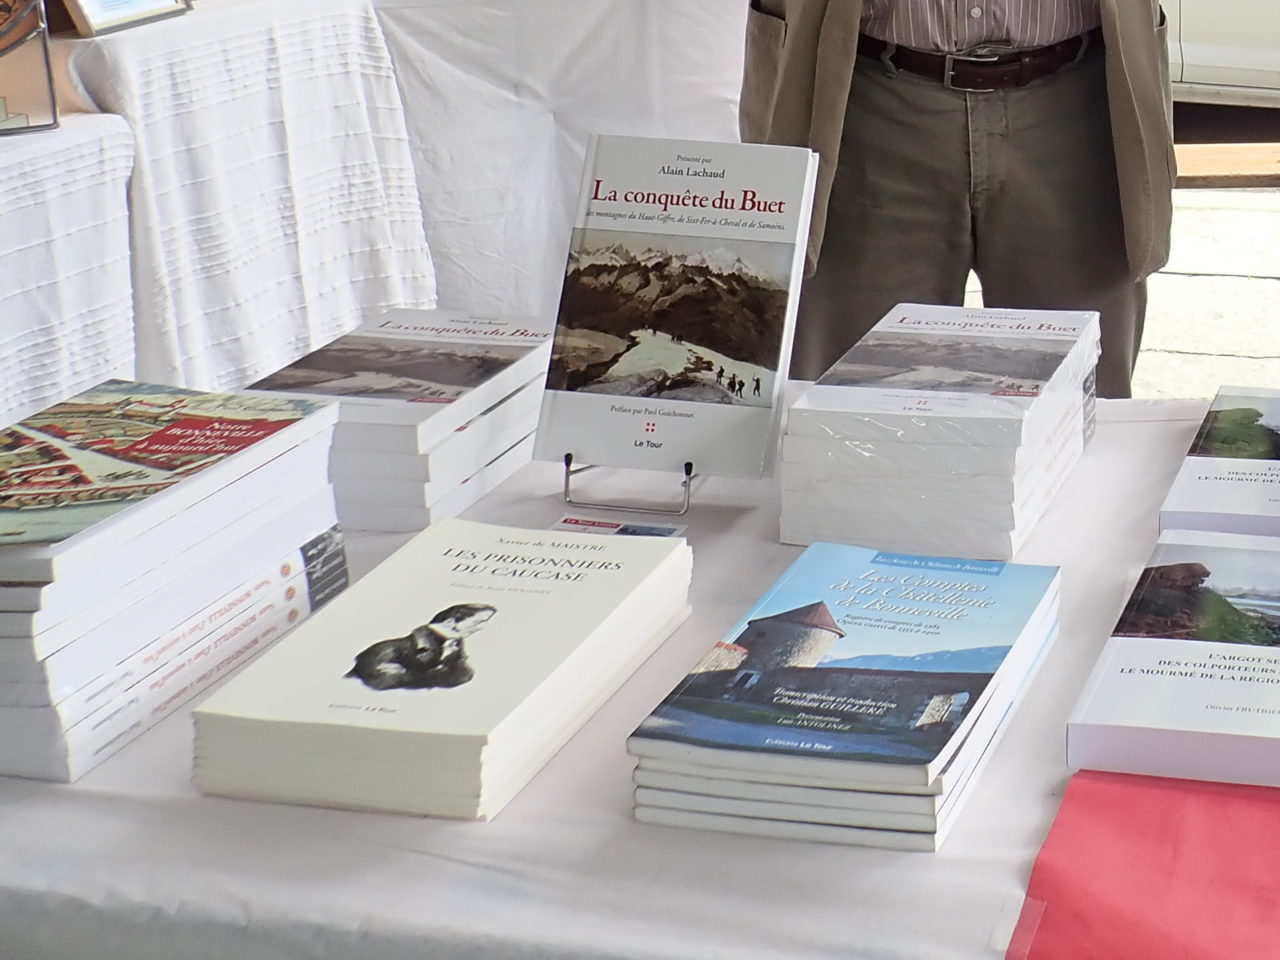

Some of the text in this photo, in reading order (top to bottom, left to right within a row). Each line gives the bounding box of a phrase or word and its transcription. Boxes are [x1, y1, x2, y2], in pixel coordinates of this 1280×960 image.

[658, 165, 726, 179] Alain Lachaud
[591, 179, 786, 214] La conquête du Buet
[595, 210, 627, 220] montagnes
[628, 211, 637, 220] du
[676, 214, 685, 223] de
[748, 220, 757, 229] de
[378, 320, 402, 329] La
[402, 324, 484, 335] conquête
[483, 327, 505, 336] du
[508, 328, 552, 338] Buet
[897, 316, 1080, 332] La conquête du Buet
[610, 404, 632, 414] Préface
[632, 408, 643, 417] par
[643, 407, 657, 417] Paul
[166, 428, 270, 438] BONNEVILLE
[206, 422, 253, 431] Notre
[149, 442, 246, 452] aujourd'hui
[178, 435, 228, 445] d'hier
[634, 439, 663, 450] Le Tour
[498, 538, 608, 552] Xavier de MAISTRE
[442, 547, 626, 571] LES PRISONNIERS
[451, 563, 588, 582] DU CAUCASE
[858, 569, 989, 593] Les Comptes
[829, 578, 998, 609] de la Châtellenie
[834, 594, 970, 621] de Bonneville
[1208, 652, 1263, 664] L'ARGOT
[1158, 659, 1182, 668] DES
[1183, 661, 1278, 675] COLPORTEURS
[1119, 667, 1136, 676] LE
[1138, 667, 1198, 679] MOURMÉ
[1200, 672, 1217, 680] DE
[1219, 674, 1238, 683] LA
[772, 686, 898, 710] Transcription et traduction
[772, 695, 820, 709] Christian
[1205, 703, 1234, 713] Olivier
[794, 719, 853, 731] ANTOLINEZ
[764, 738, 834, 752] Editions Le Tour
